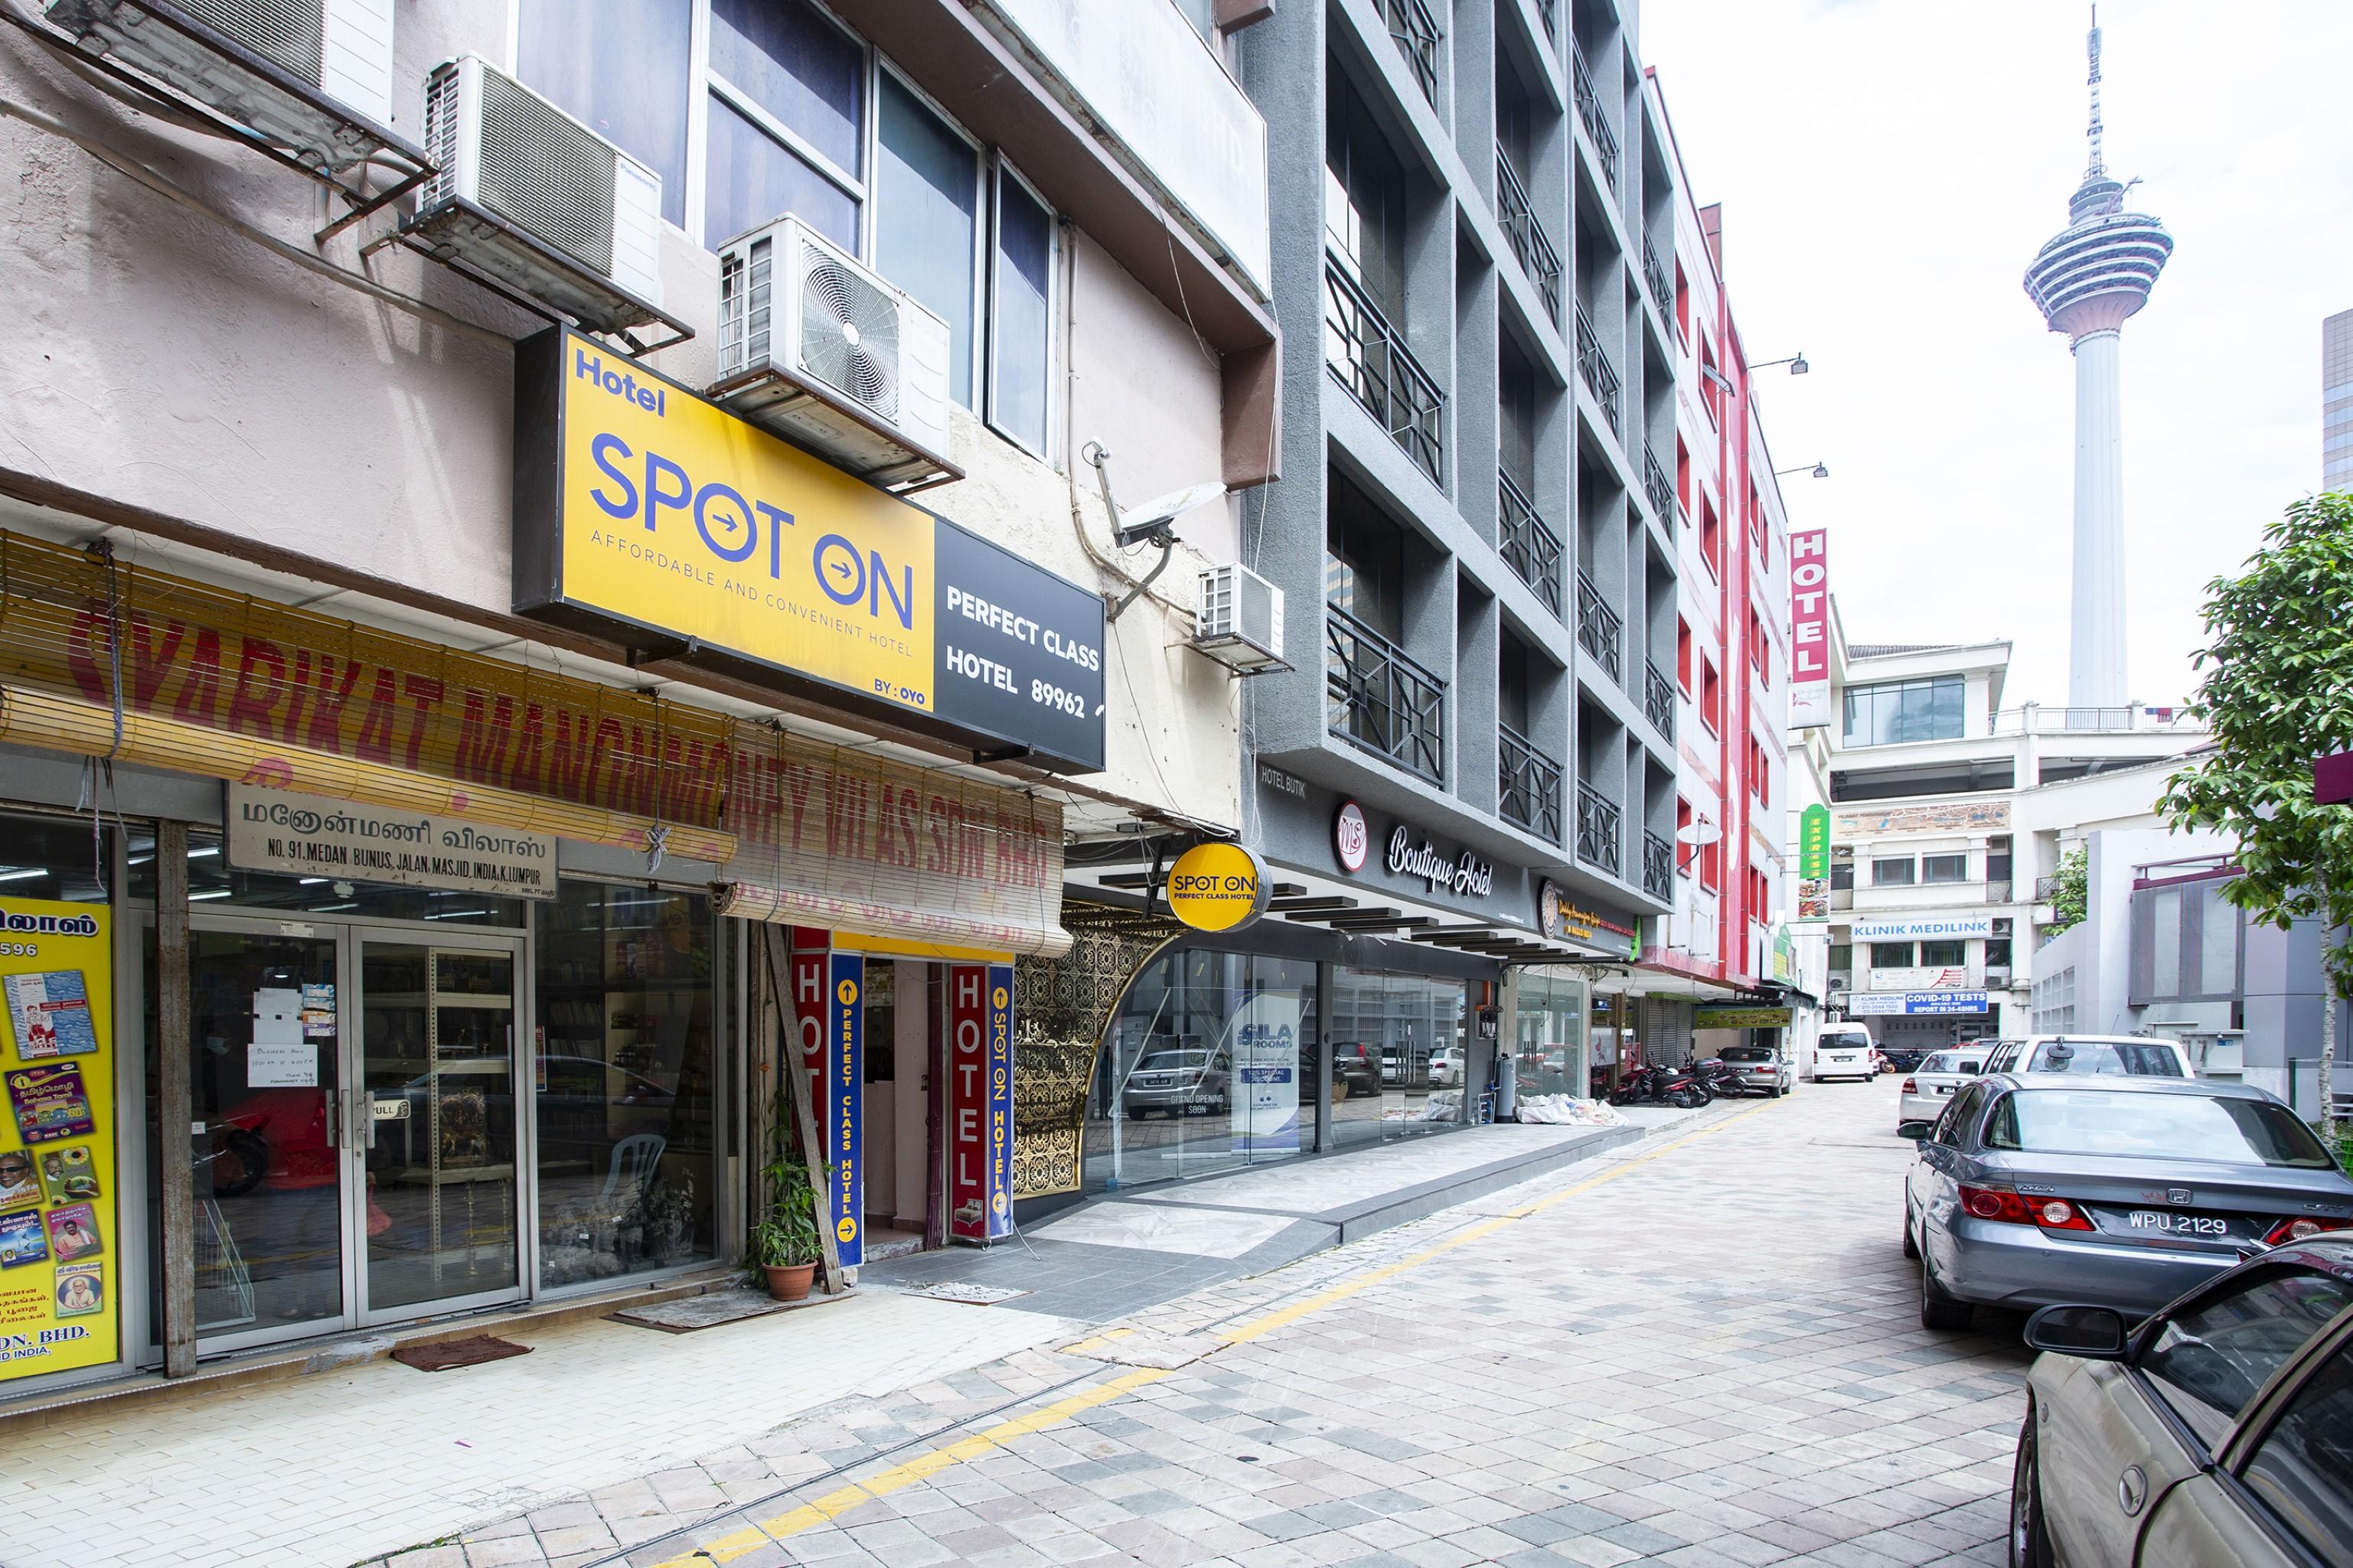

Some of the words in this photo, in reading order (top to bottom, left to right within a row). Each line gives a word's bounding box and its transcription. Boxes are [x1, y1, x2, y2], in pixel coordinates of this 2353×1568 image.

[576, 348, 665, 417] Hotel
[589, 432, 795, 579] SPOT
[813, 533, 913, 631] ON
[591, 529, 716, 587] AFFORDABLE
[723, 578, 758, 601] AND
[765, 593, 863, 636] CONVENIENT
[870, 631, 912, 657] HOTEL
[1792, 533, 1826, 673] HOTEL
[947, 585, 1039, 646] PERFECT
[1043, 629, 1100, 673] CLASS
[900, 687, 925, 706] OYO
[946, 644, 1019, 695] HOTEL
[1032, 679, 1085, 719] 89962
[1261, 766, 1285, 790] HOTEL
[1286, 776, 1305, 797] BUTIK
[268, 839, 286, 858] NO.
[306, 843, 348, 865] MEDAN
[1389, 826, 1454, 894] Boutique
[1454, 851, 1493, 897] Hotel
[1810, 818, 1821, 877] EXPRESS
[1174, 875, 1220, 892] SPOT
[1225, 875, 1255, 892] ON
[1855, 925, 1905, 936] KLINIK
[1911, 921, 1988, 934] MEDILINK
[1907, 993, 1951, 1002] COVID-19
[1952, 993, 1986, 1001] TESTS
[843, 1009, 852, 1086] PERFECT
[994, 1012, 1007, 1063] SPOT
[24, 1095, 52, 1104] Bahasa
[52, 1091, 73, 1100] Tamil
[957, 974, 981, 1187] HOTEL
[994, 1068, 1007, 1100] ON
[1195, 1094, 1224, 1103] OPENING
[842, 1095, 852, 1151] CLASS
[1188, 1105, 1207, 1114] SOON
[994, 1111, 1005, 1189] HOTEL
[842, 1159, 852, 1214] HOTEL
[2129, 1212, 2171, 1231] WPU
[2177, 1217, 2227, 1234] 2129
[38, 1326, 90, 1344] BHD.
